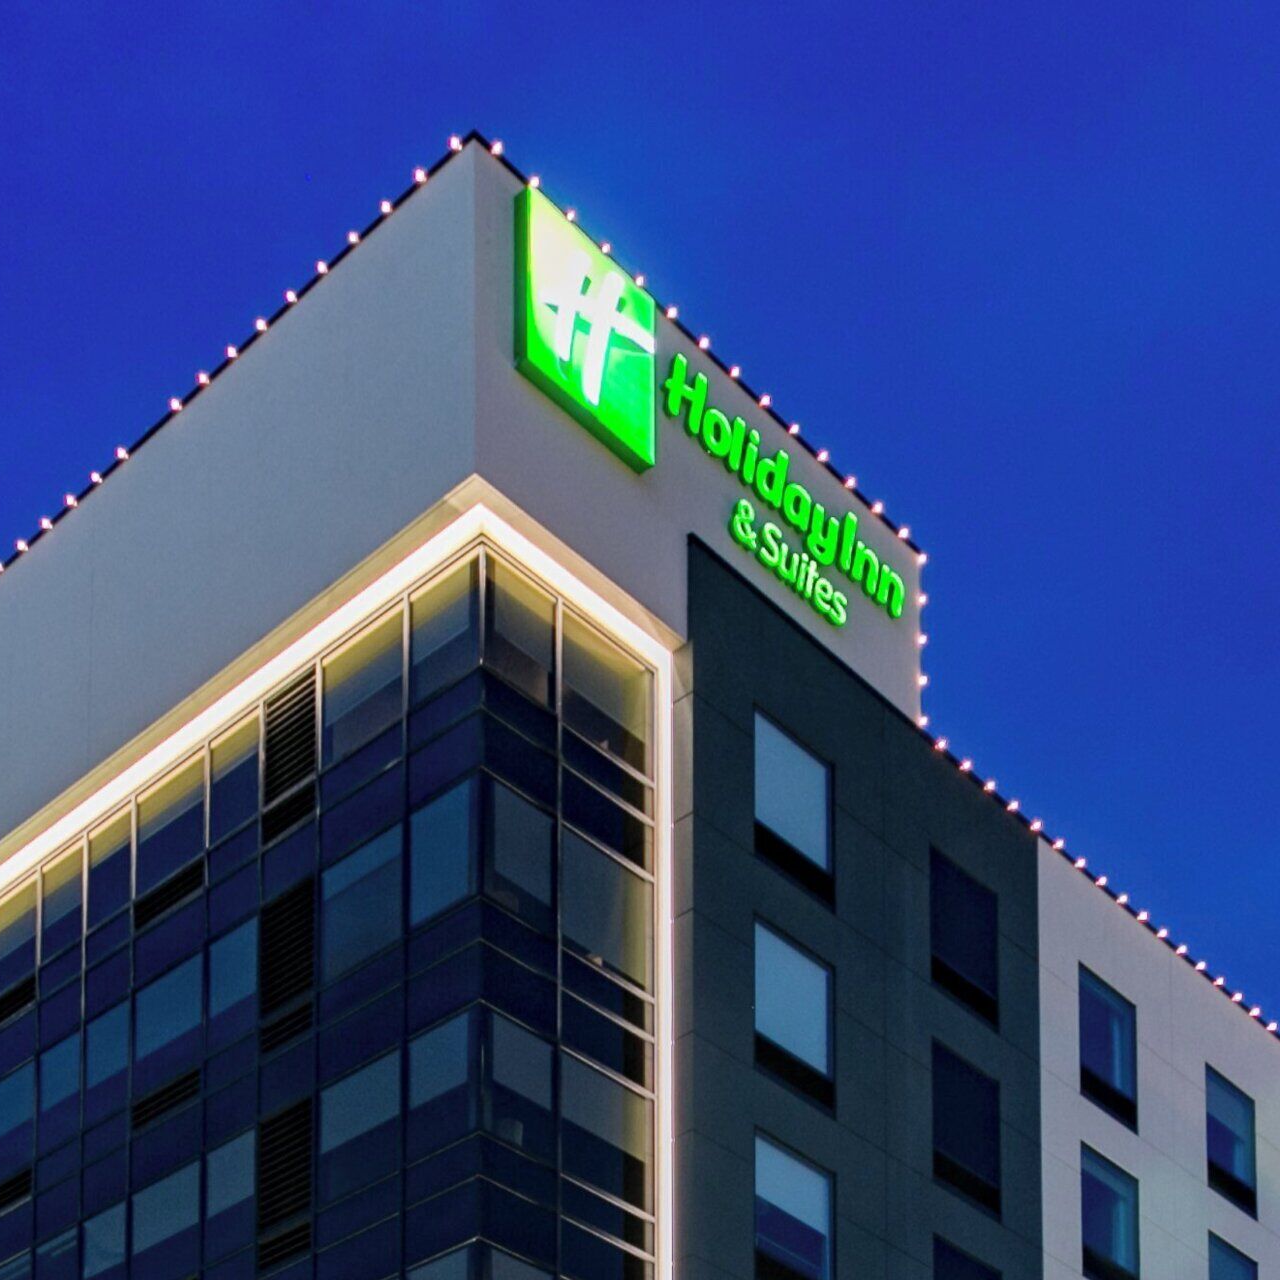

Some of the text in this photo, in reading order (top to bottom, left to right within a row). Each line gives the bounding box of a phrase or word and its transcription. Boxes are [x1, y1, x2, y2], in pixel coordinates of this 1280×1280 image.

[663, 352, 905, 618] Holiday Inn
[730, 499, 850, 628] & Suites
